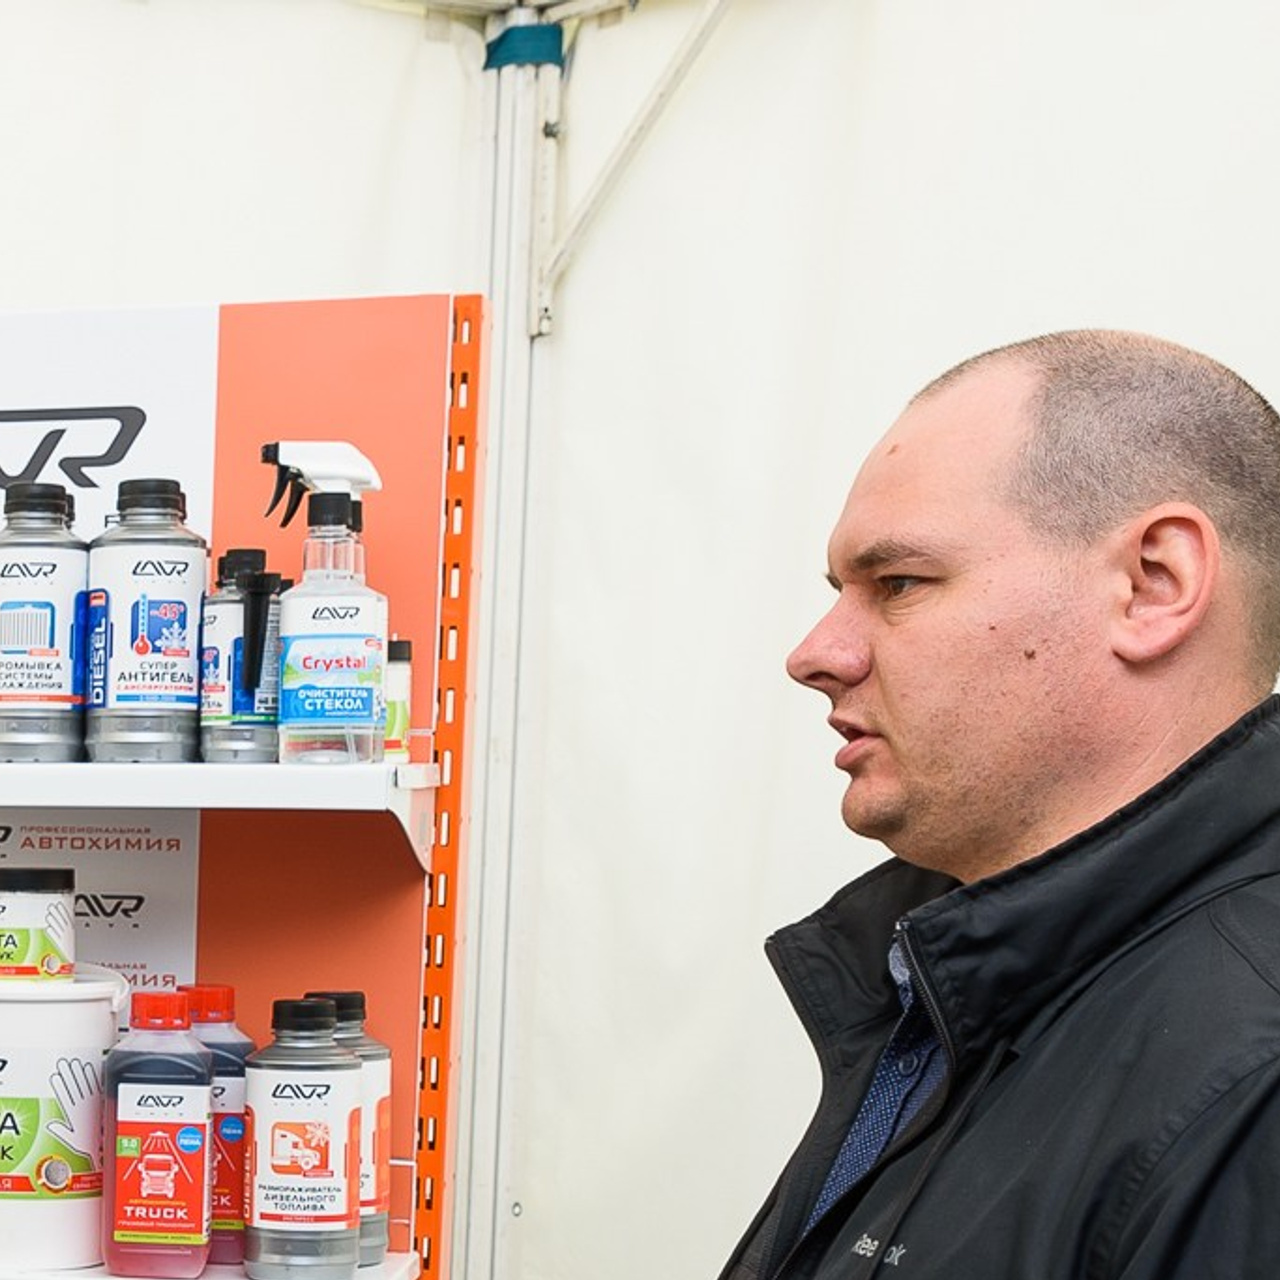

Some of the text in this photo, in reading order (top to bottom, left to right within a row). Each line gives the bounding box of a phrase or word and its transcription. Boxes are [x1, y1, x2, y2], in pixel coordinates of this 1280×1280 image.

[0, 562, 57, 578] LAVR
[132, 560, 189, 576] LAVR
[312, 606, 360, 619] LAVR
[93, 617, 106, 704] DIESEL
[303, 656, 366, 671] Crystal
[117, 672, 194, 683] АНТИГЕЛЬ
[297, 689, 369, 699] ОЧИСТИТЕЛЬ
[304, 699, 363, 711] СТЕКОЛ
[21, 836, 181, 851] АВТОХИМИЯ
[271, 1083, 331, 1099] LAVR
[136, 1094, 185, 1108] LAVR
[264, 1193, 336, 1203] ДИЗЕЛЬНОГО
[123, 1206, 188, 1219] TRUCK
[274, 1202, 326, 1211] ТОПЛИВА
